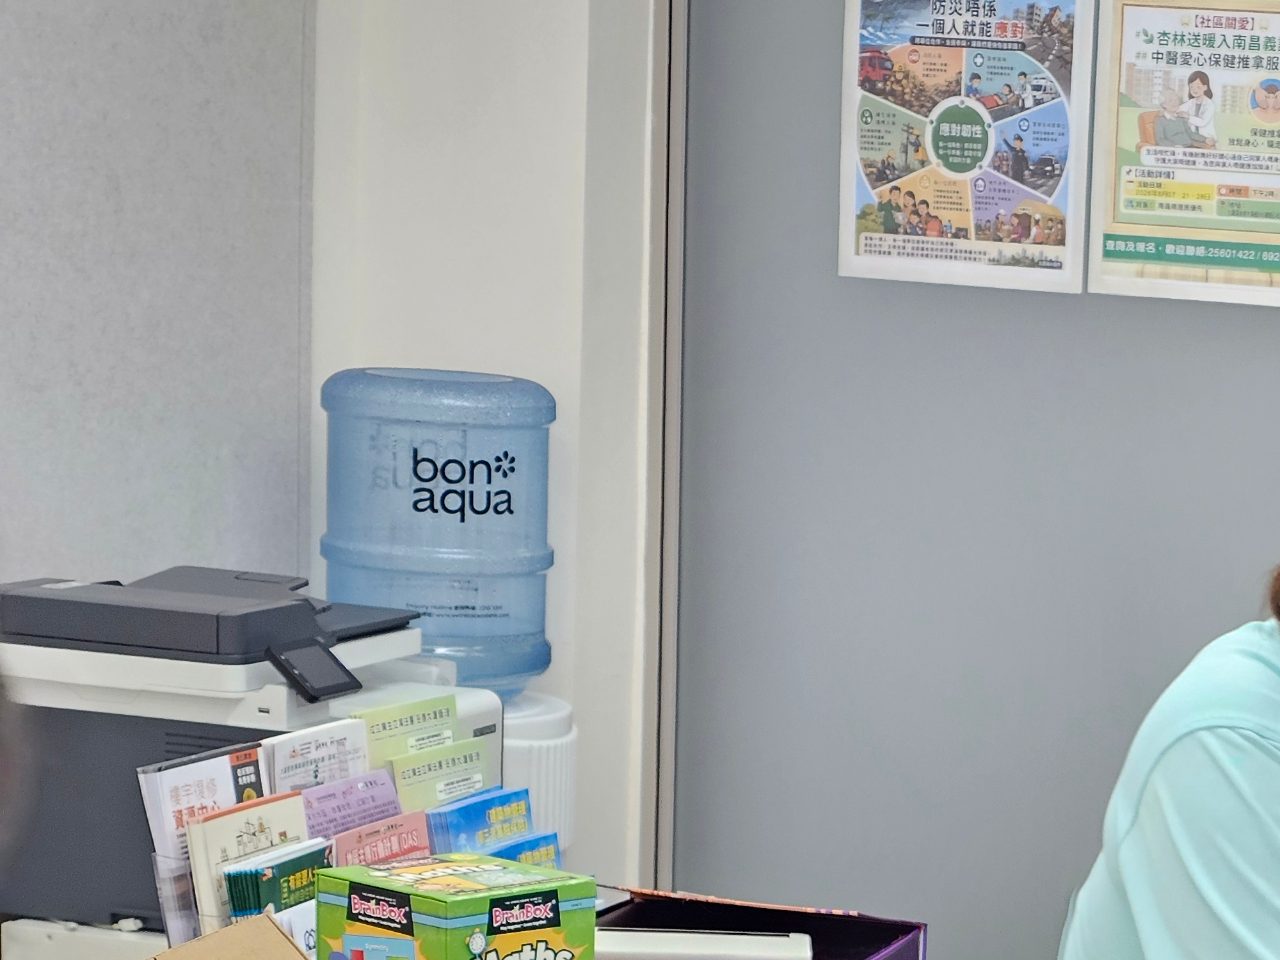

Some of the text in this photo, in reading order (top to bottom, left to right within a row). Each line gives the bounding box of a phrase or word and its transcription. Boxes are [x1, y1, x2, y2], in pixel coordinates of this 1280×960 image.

[915, 18, 1025, 39] 一個人就能應對
[412, 447, 492, 485] bon
[412, 487, 514, 523] aqua
[351, 894, 407, 924] BrainBox
[492, 903, 554, 927] BrainBox
